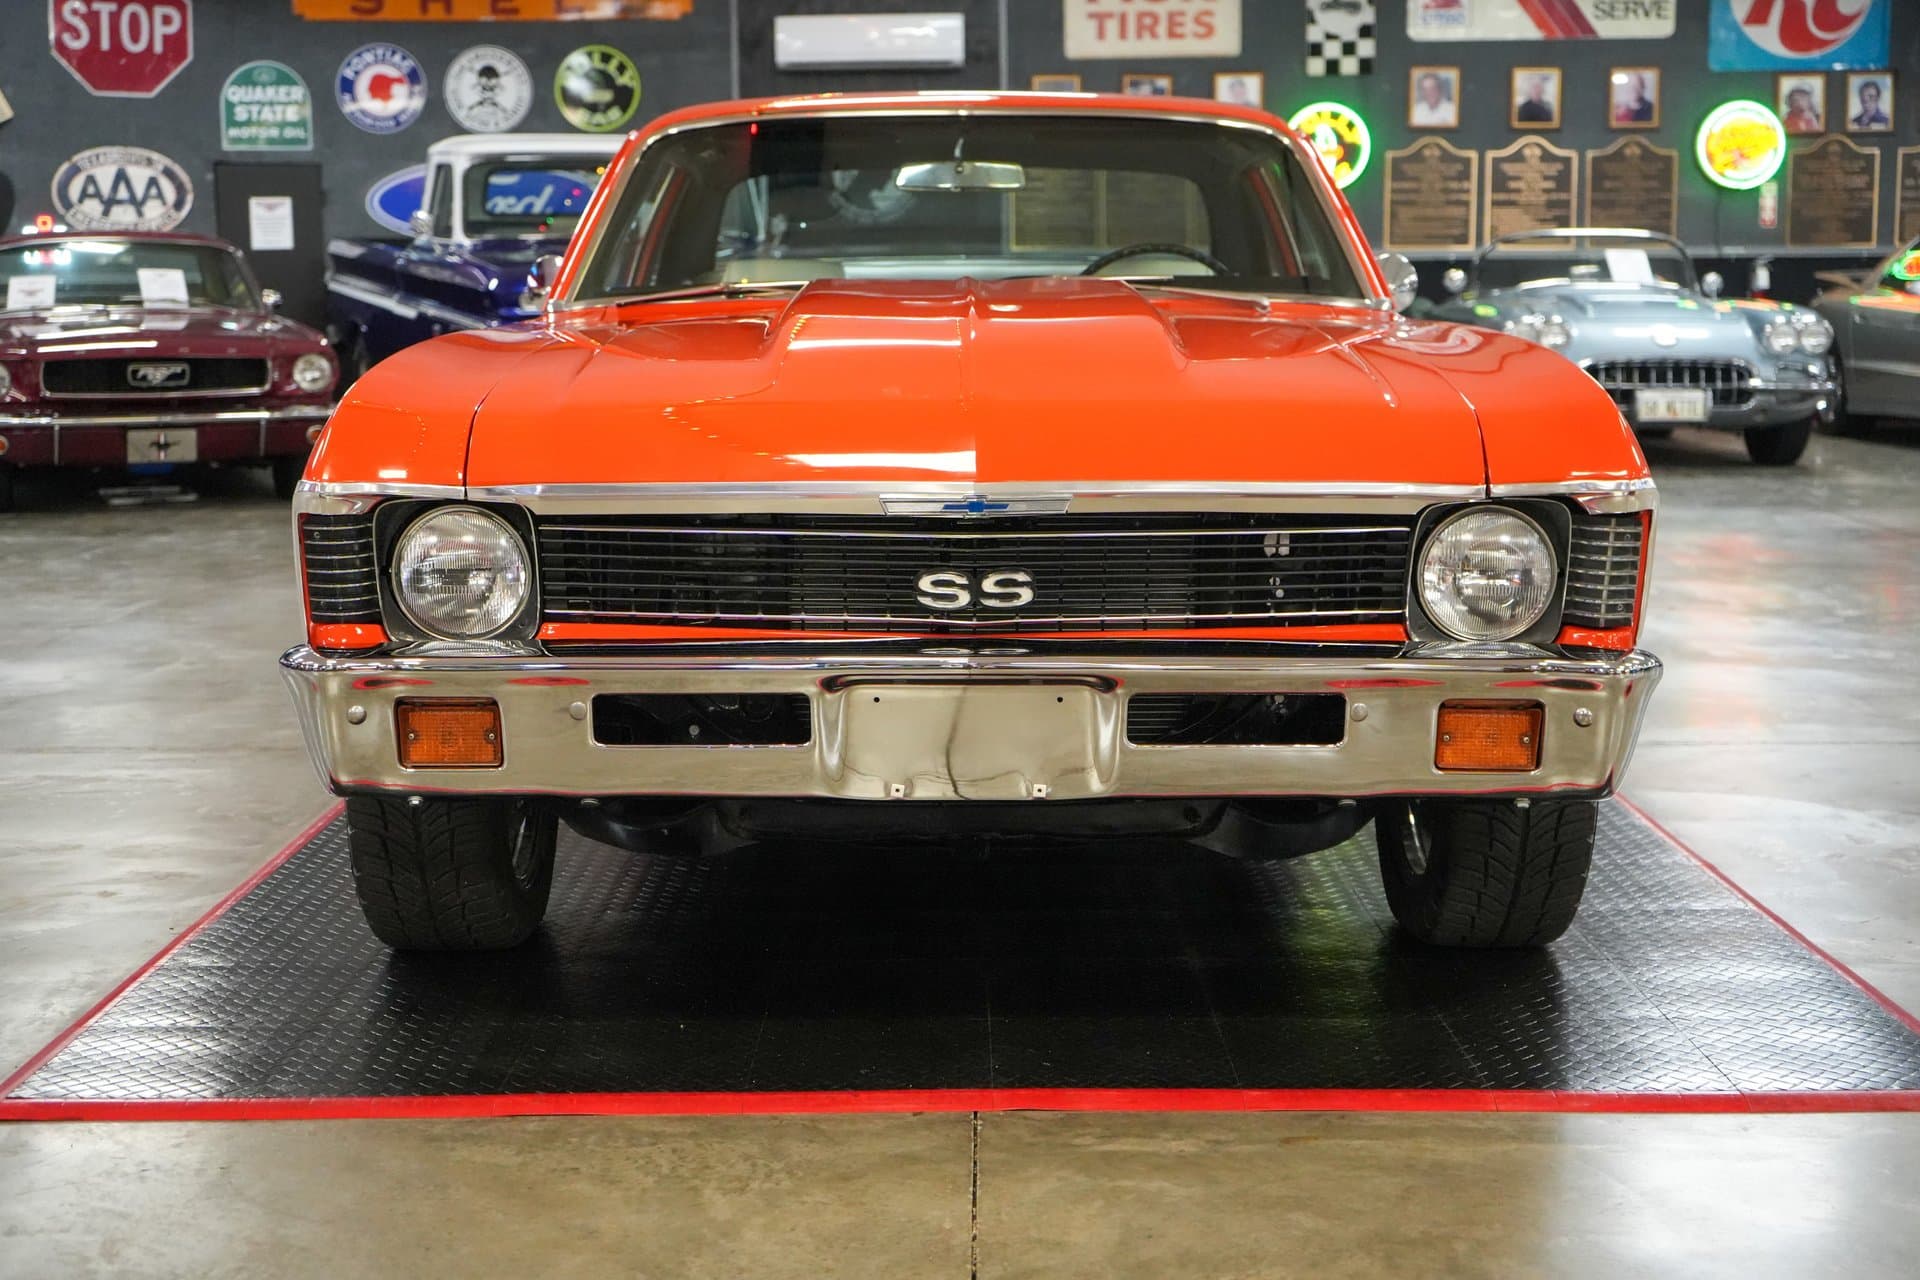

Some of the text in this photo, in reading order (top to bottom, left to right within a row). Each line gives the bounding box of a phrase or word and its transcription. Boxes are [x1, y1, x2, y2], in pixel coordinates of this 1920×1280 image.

[1087, 10, 1216, 41] TIRES
[1592, 0, 1670, 20] SERVE
[61, 0, 182, 54] STOP
[227, 84, 305, 104] QUAKER
[234, 104, 300, 122] STATE
[228, 127, 306, 139] MOTOR OIL
[78, 167, 166, 218] AAA
[485, 173, 554, 215] ord
[915, 569, 1035, 611] SS
